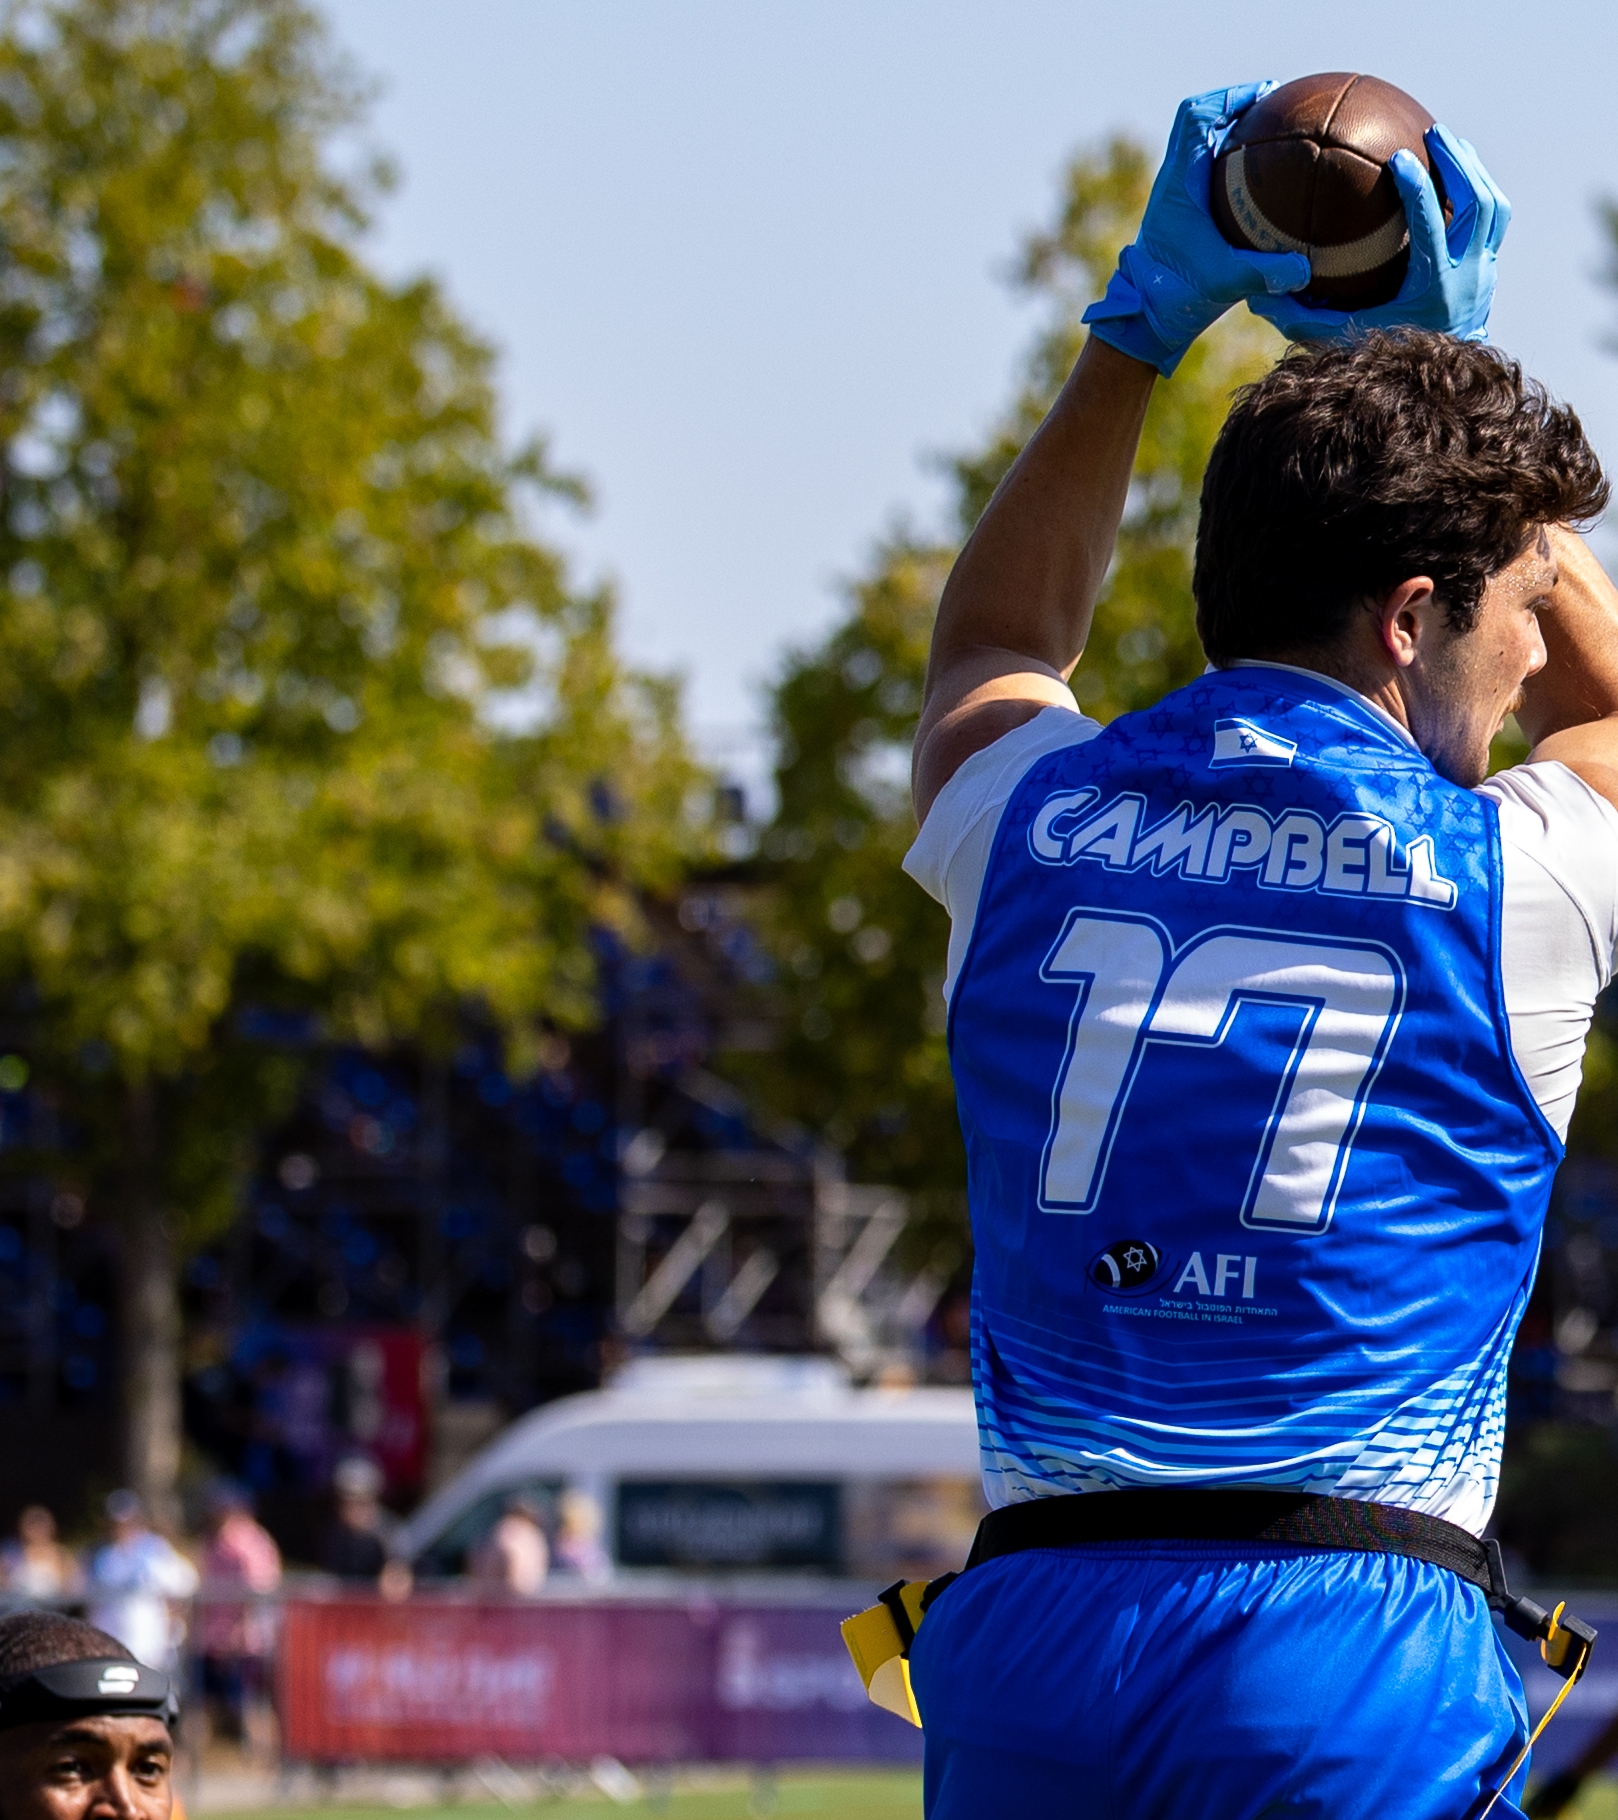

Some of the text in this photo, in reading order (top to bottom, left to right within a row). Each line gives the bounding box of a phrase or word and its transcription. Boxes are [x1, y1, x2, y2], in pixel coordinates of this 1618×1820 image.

[1027, 786, 1459, 911] CAMPBELL
[1037, 906, 1407, 1235] 17
[1173, 1251, 1258, 1299] AFI
[1102, 1304, 1244, 1324] AMERICAN FOOTBALL IN ISRAEL
[1159, 1298, 1194, 1310] בישראל
[1235, 1306, 1278, 1317] התאחדות
